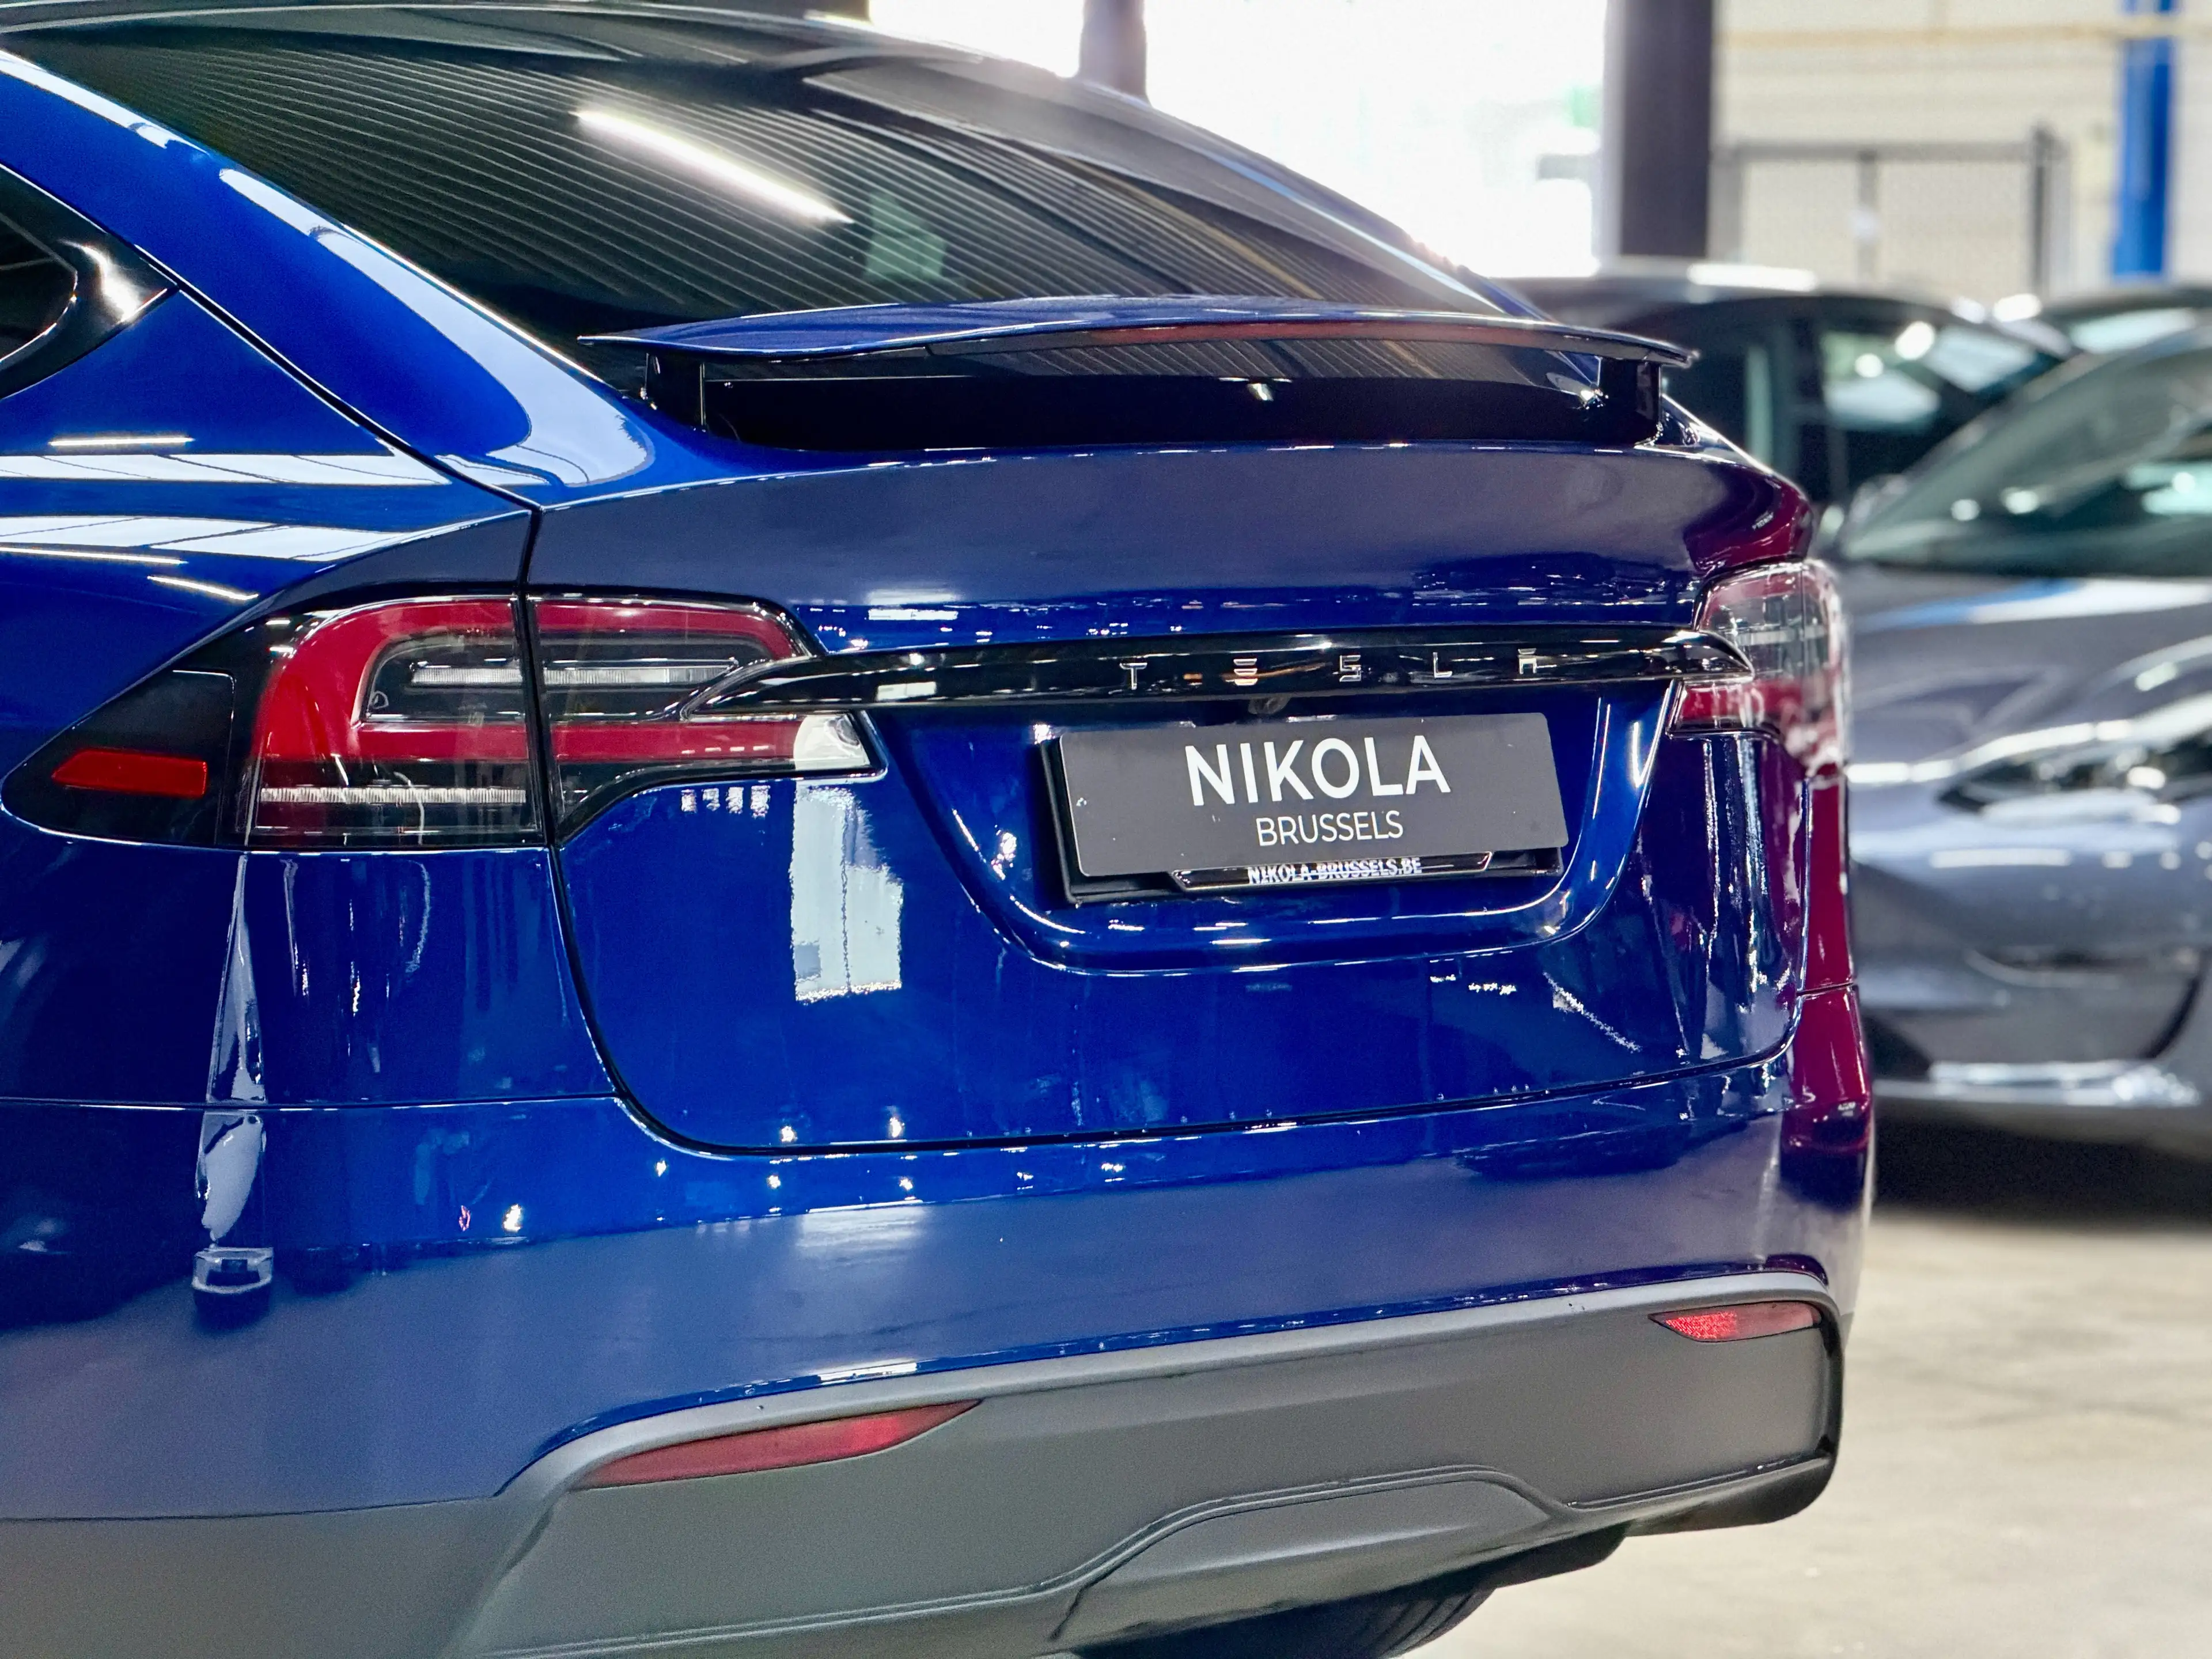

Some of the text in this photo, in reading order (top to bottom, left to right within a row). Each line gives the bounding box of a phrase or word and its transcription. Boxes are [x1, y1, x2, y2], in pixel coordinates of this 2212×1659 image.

[1119, 647, 1537, 691] TESLA
[1185, 736, 1451, 806] NIKOLA
[1256, 810, 1404, 846] BRUSSELS
[1248, 857, 1422, 884] NIKOLA-BRUSSELS.BE
